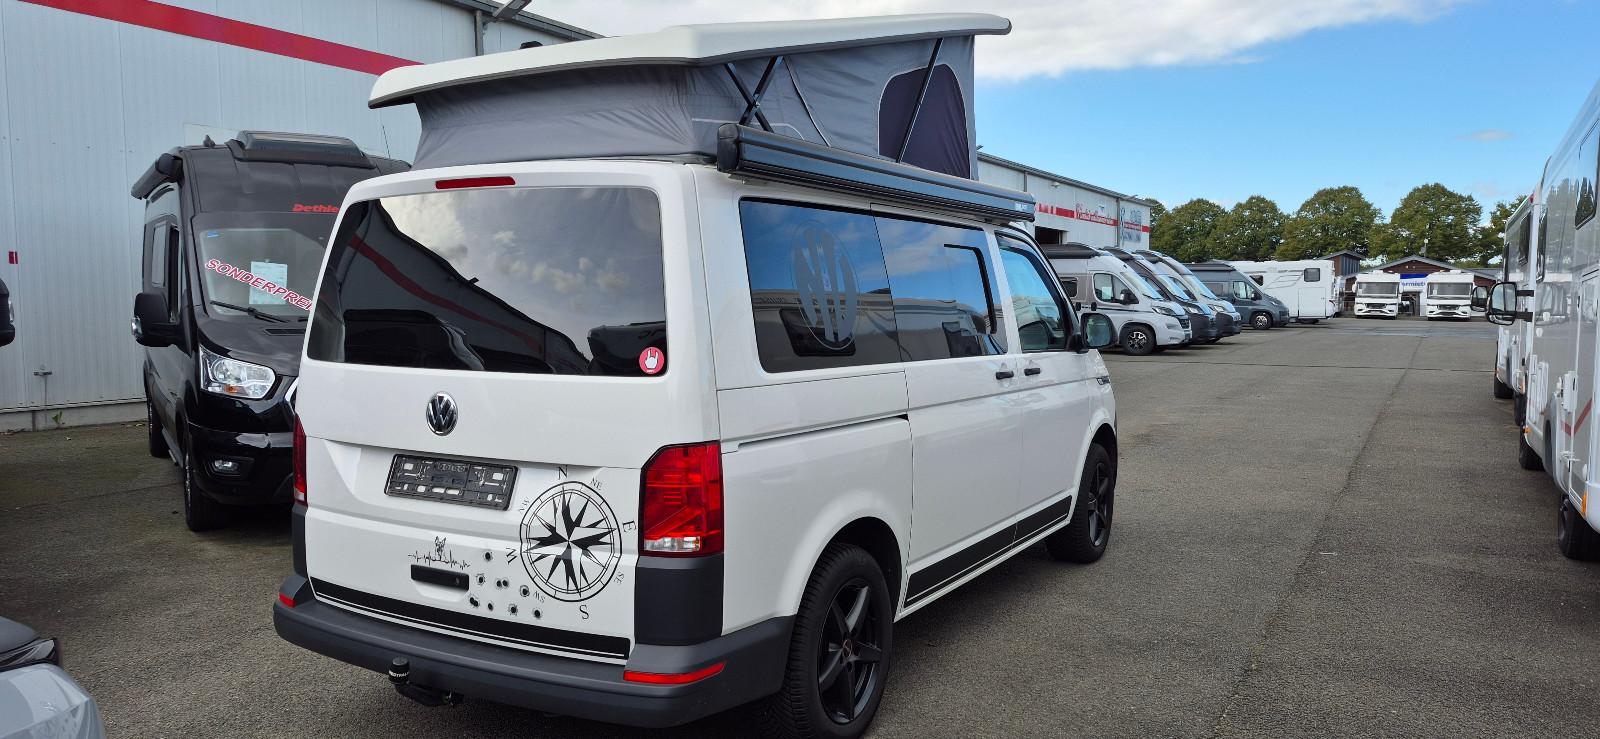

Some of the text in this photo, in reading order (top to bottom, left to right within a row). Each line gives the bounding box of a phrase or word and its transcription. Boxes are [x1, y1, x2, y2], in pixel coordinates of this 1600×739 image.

[426, 392, 459, 436] VW
[558, 464, 568, 480] N
[590, 478, 603, 491] NE
[622, 520, 637, 533] E
[579, 604, 590, 620] S
